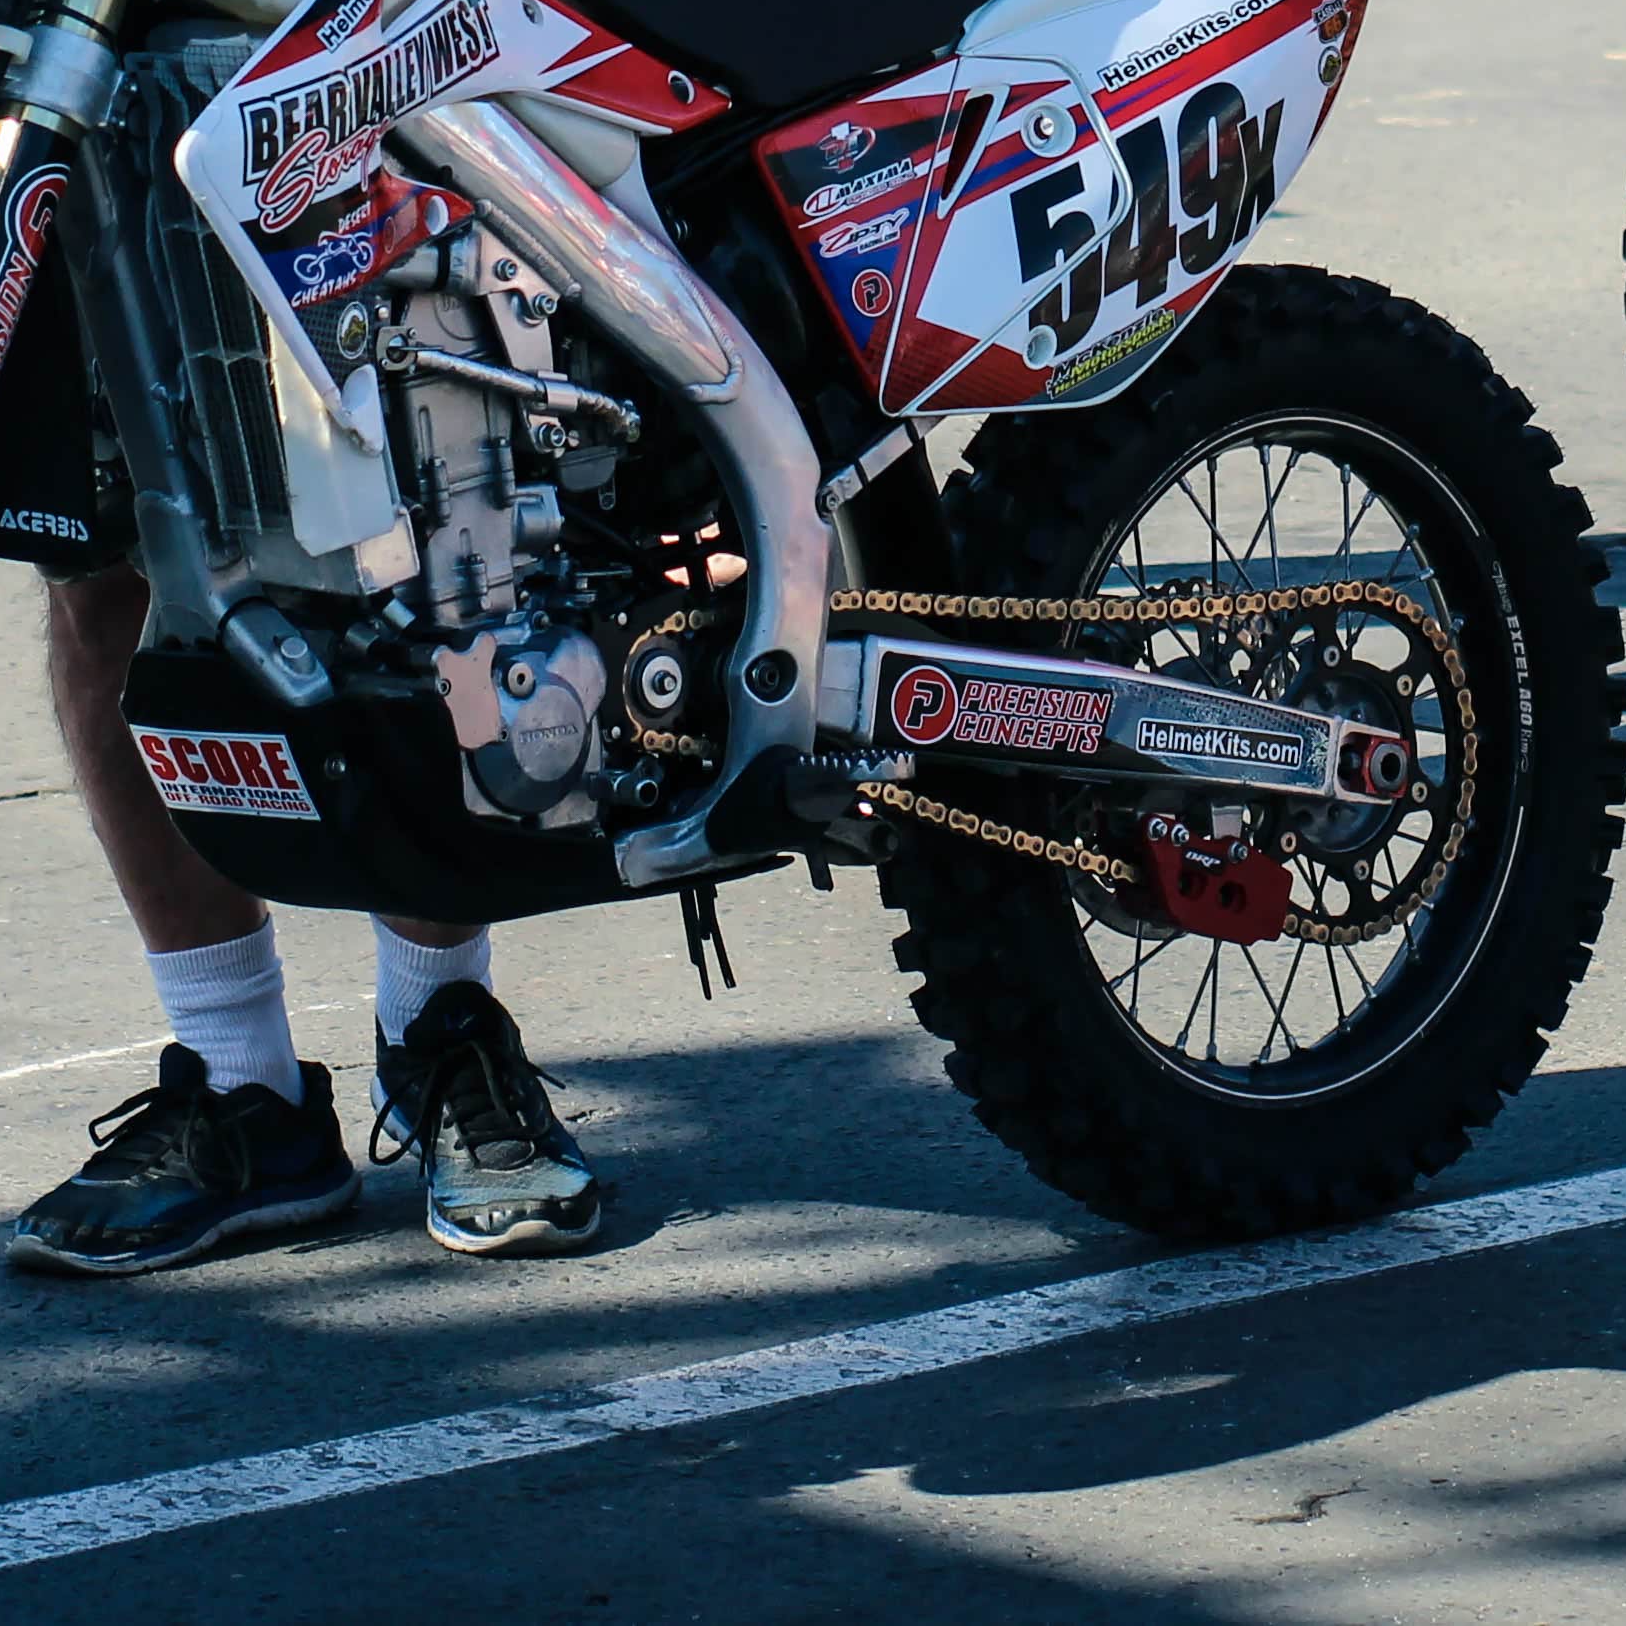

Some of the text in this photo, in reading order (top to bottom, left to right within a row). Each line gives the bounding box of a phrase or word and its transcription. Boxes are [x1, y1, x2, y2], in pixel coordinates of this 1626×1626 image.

[247, 77, 351, 174] BEAR
[349, 29, 428, 124] VALLEY
[835, 158, 913, 200] MAXIMA
[337, 200, 372, 234] DESERT
[1009, 80, 1285, 356] 549X
[291, 269, 359, 308] CHEATAHS
[0, 507, 89, 542] ACERBIS
[1505, 615, 1529, 684] EXCEL
[1518, 687, 1533, 726] A60
[904, 680, 947, 730] P
[960, 680, 1112, 724] PRECISION
[953, 712, 1104, 754] CONCEPTS
[1140, 722, 1300, 765] HelmetKits.com
[139, 734, 301, 790] SCORE
[160, 781, 306, 802] INTERNATIONAL
[164, 792, 312, 813] OFF-ROAD RACING
